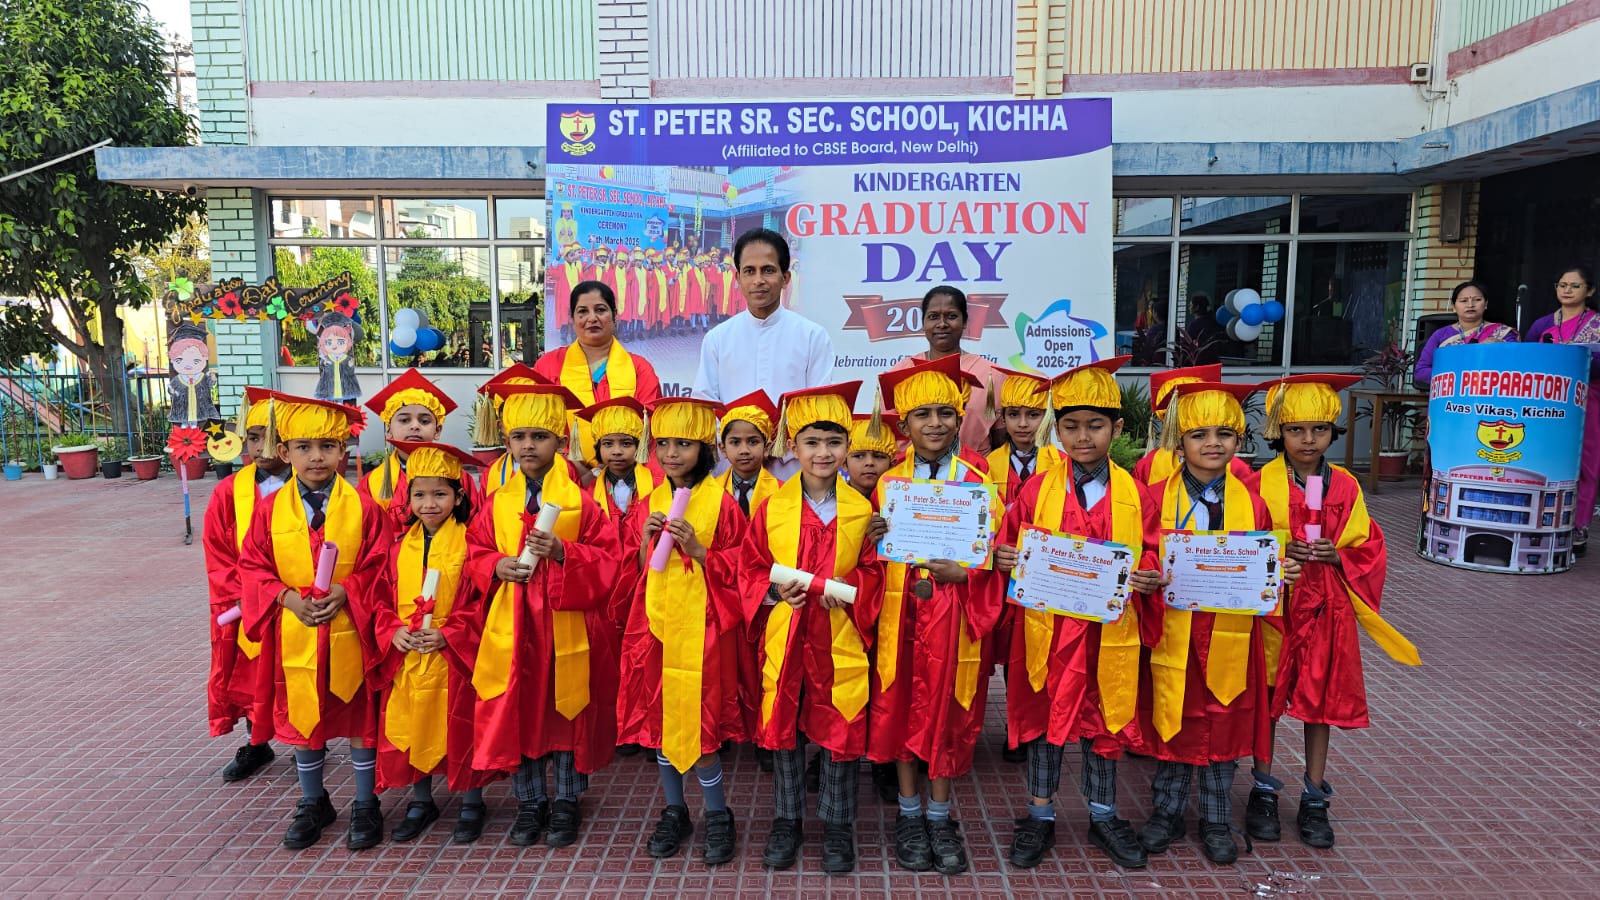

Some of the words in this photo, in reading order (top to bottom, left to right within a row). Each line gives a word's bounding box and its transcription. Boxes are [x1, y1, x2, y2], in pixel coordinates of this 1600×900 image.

[608, 109, 646, 136] ST.
[654, 109, 733, 135] PETER
[740, 108, 779, 134] SR.
[787, 106, 842, 133] SEC.
[850, 105, 959, 136] SCHOOL,
[968, 104, 1068, 132] KICHHA
[721, 143, 790, 160] (Affiliated
[794, 144, 809, 157] to
[812, 142, 847, 156] CBSE
[851, 141, 897, 155] Board,
[901, 140, 933, 153] New
[937, 140, 979, 157] Delhi)
[854, 172, 1020, 192] KINDERGARTEN
[786, 201, 1089, 237] GRADUATION
[861, 241, 1013, 283] DAY
[242, 278, 278, 304] Day
[285, 271, 351, 314] Ceremony
[886, 305, 923, 332] 20
[1026, 325, 1091, 337] Admissions
[1044, 339, 1074, 354] Open
[834, 355, 887, 368] lebration
[1037, 355, 1081, 368] 2026-27
[1460, 371, 1571, 403] PREPARATORY
[1445, 401, 1471, 414] Avas
[1475, 404, 1517, 418] Vikas,
[1522, 406, 1565, 418] Kichha
[953, 498, 972, 507] School
[1051, 547, 1067, 557] Peter
[1092, 556, 1113, 566] School
[1195, 547, 1211, 555] Peter
[1238, 547, 1259, 556] School
